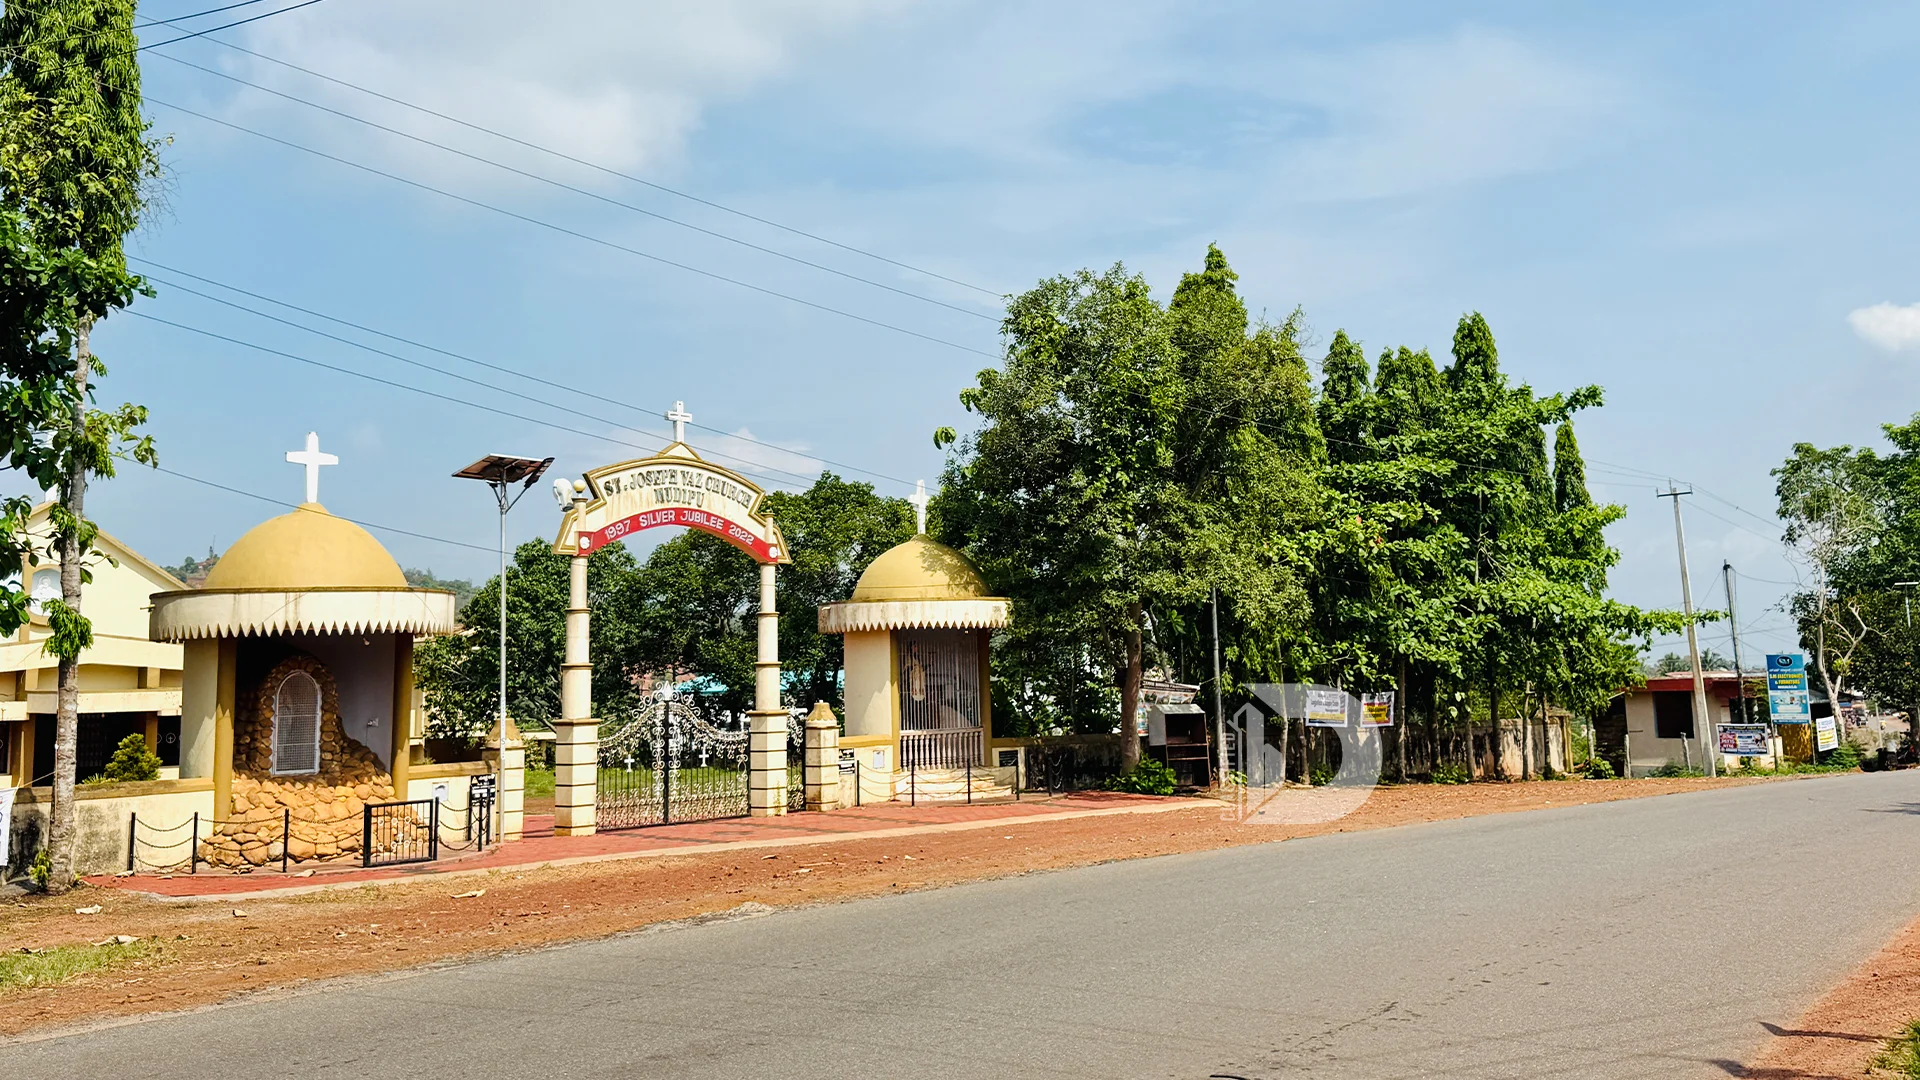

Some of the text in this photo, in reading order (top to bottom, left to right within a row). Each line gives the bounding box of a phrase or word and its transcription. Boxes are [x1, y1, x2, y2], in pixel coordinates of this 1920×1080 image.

[630, 469, 678, 490] JOSEPH
[680, 470, 704, 489] VAZ
[705, 476, 753, 510] CHURCH
[605, 510, 755, 546] 1997 SILVER JUBILEE 2022
